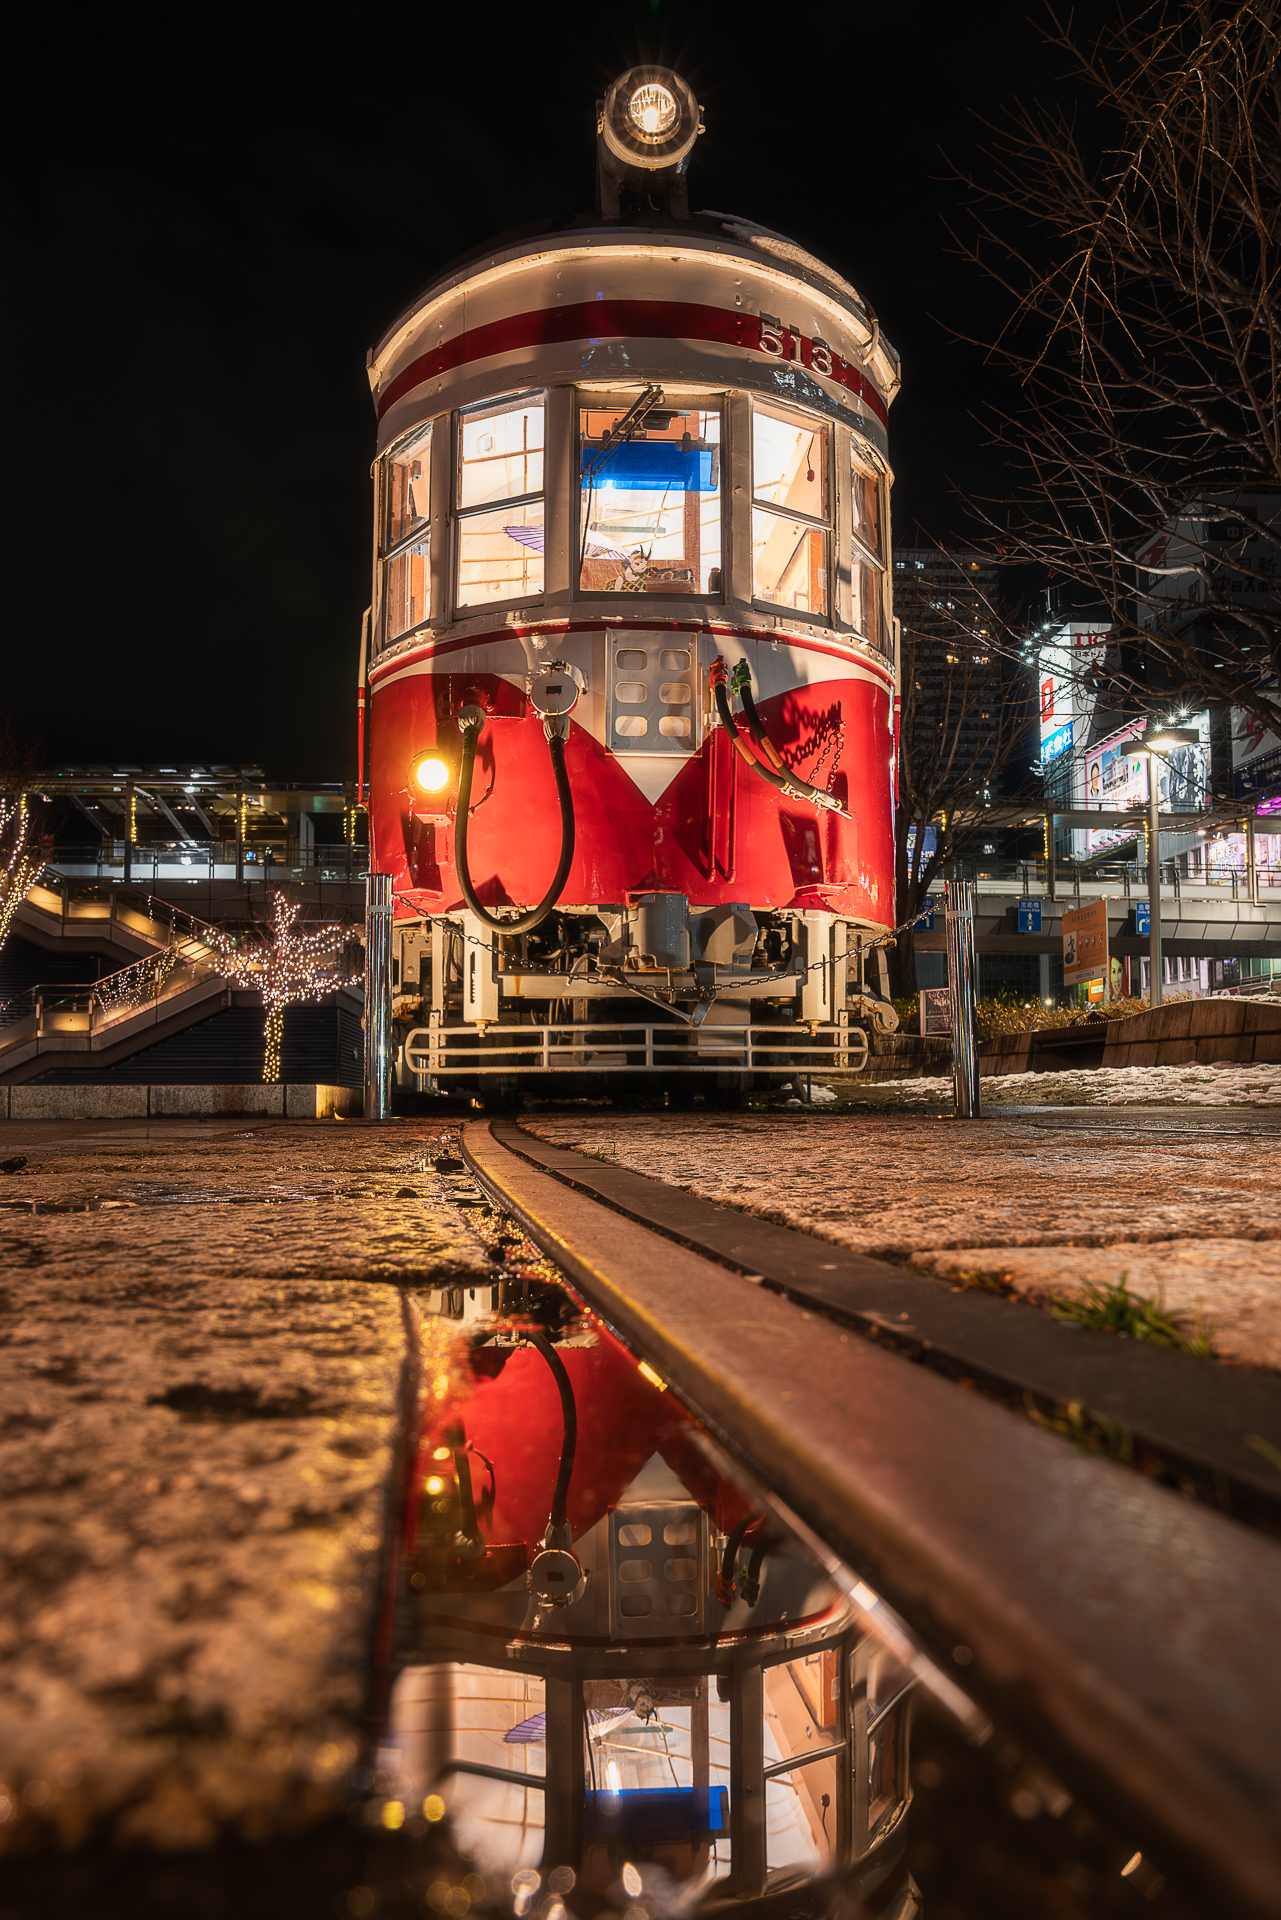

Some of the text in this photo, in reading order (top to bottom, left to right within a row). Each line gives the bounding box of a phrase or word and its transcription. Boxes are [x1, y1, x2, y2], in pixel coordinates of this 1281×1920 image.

[759, 322, 833, 376] 513
[1074, 650, 1118, 658] 日本トムソン
